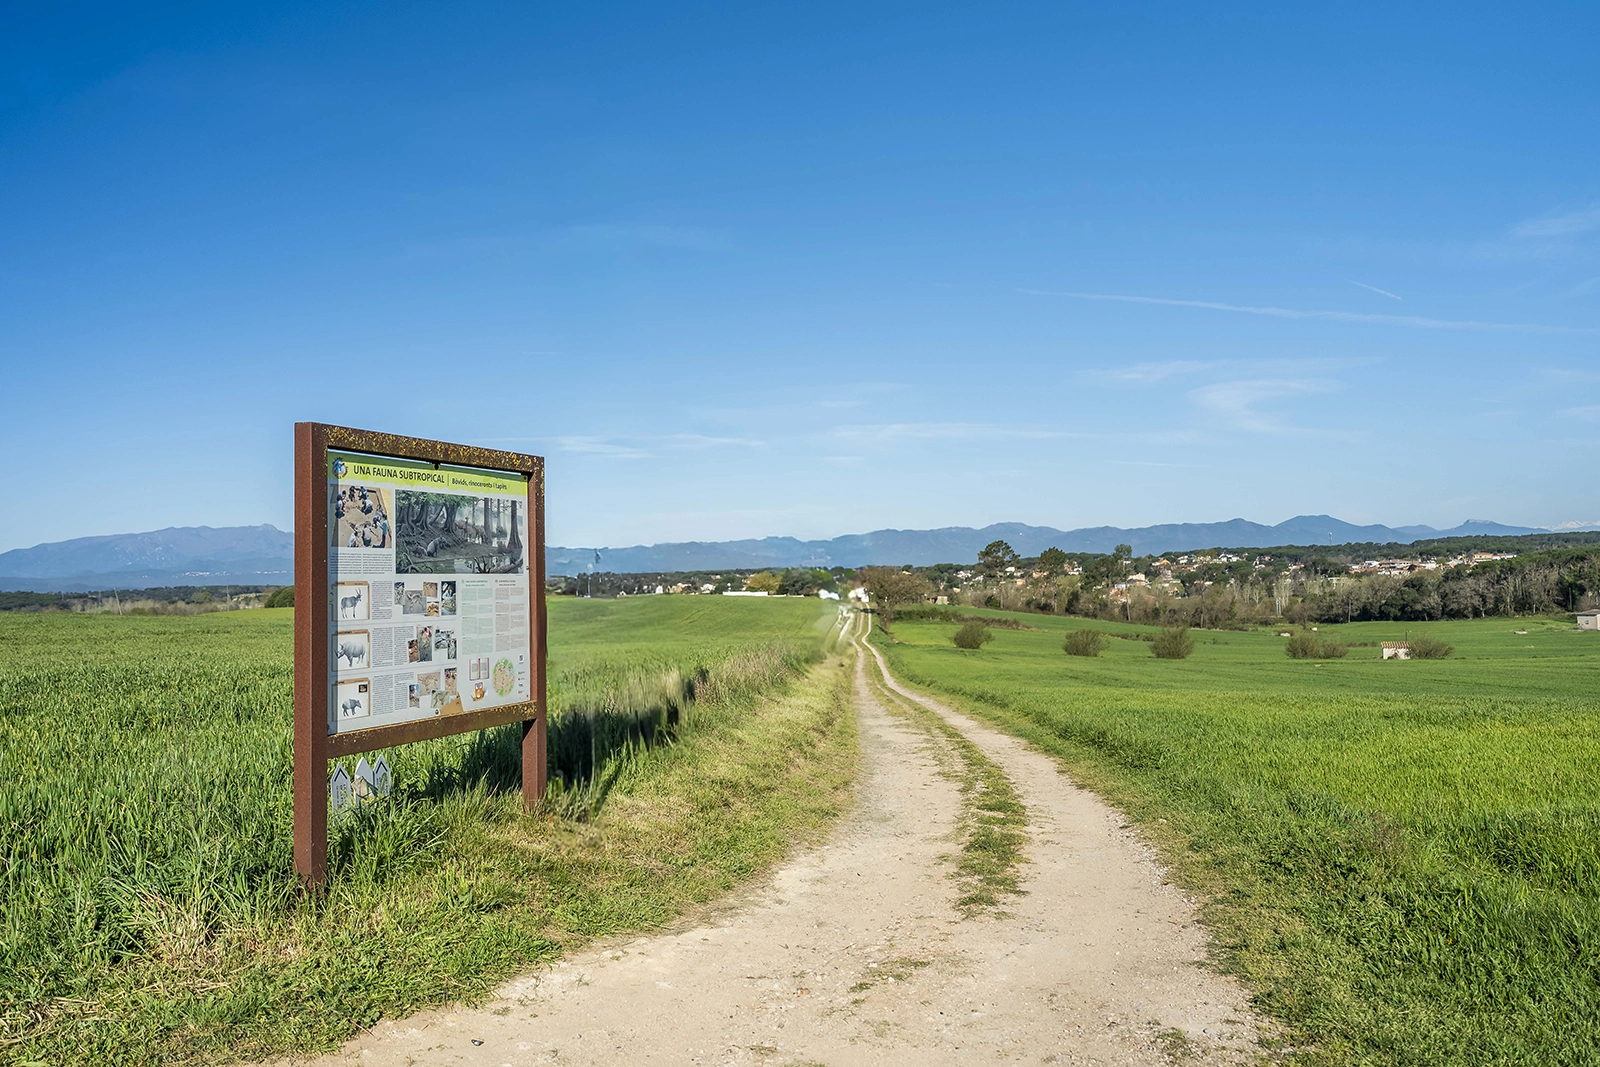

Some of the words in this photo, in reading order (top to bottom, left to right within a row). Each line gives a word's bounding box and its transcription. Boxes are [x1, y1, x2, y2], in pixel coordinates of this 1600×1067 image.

[353, 465, 371, 475] UNA
[373, 467, 398, 478] FAUNA
[399, 470, 445, 483] SUBTROPICAL
